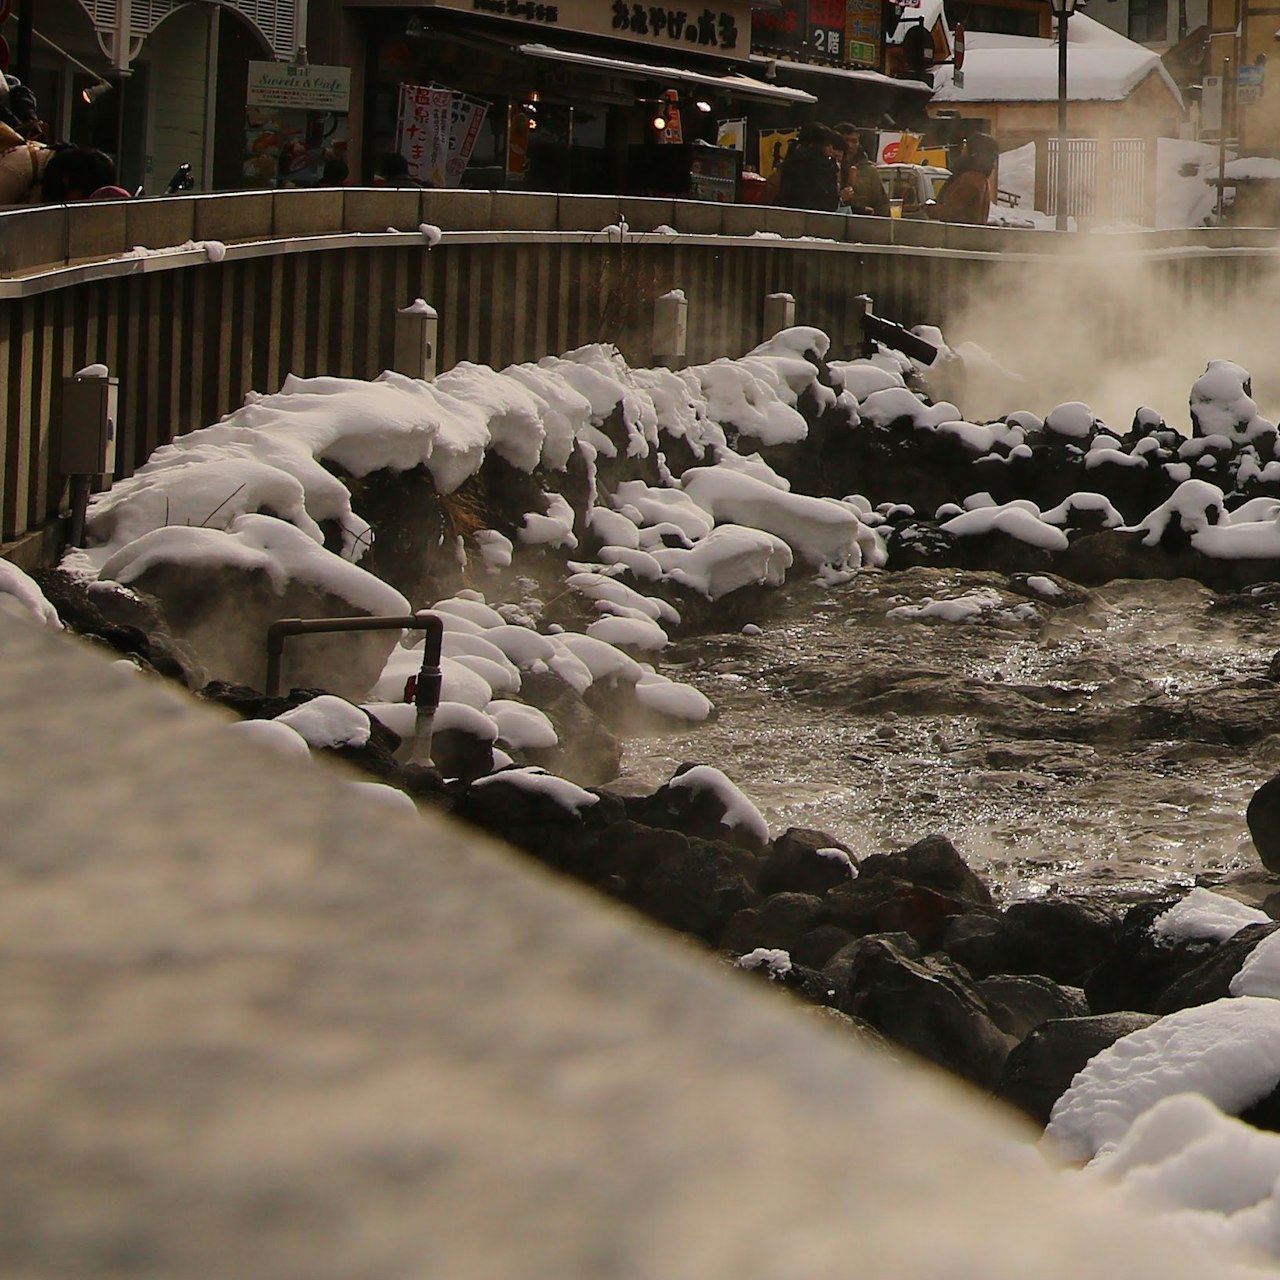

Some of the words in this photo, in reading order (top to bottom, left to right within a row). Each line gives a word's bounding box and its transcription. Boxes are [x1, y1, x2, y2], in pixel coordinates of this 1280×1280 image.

[814, 29, 840, 54] 2階
[259, 73, 299, 87] Sweets
[303, 79, 311, 88] &
[405, 85, 430, 183] 温泉たまご
